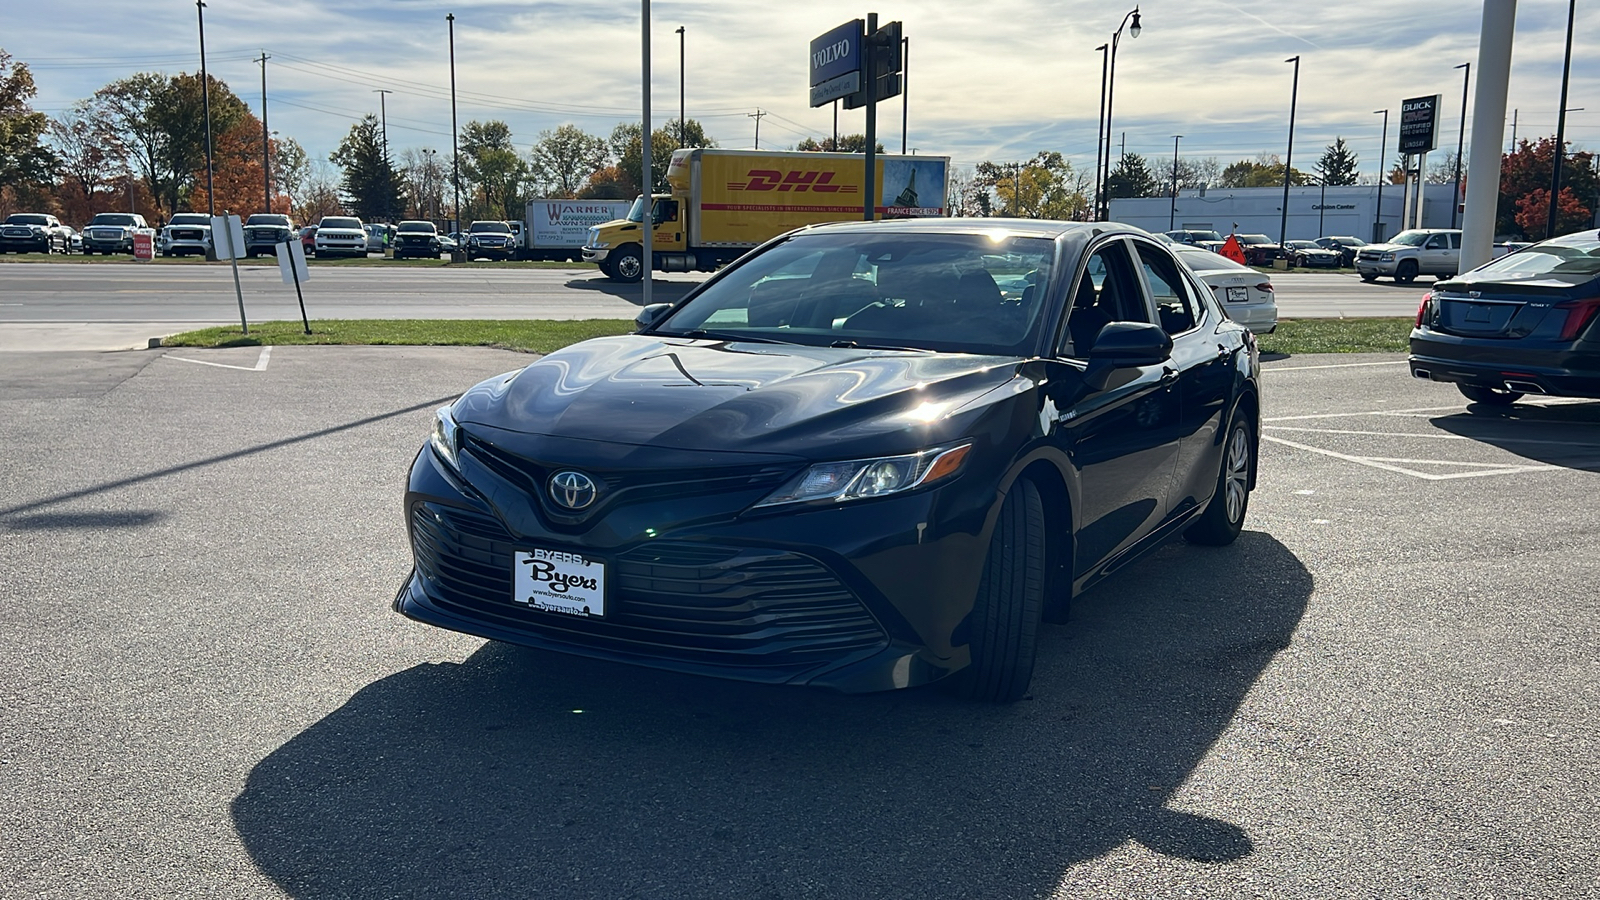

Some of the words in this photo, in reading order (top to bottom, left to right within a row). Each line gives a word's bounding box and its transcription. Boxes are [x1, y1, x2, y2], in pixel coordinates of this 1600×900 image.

[812, 39, 850, 69] VOLVO
[1403, 101, 1431, 111] BUICK
[1403, 110, 1430, 122] GMC
[1401, 122, 1431, 131] CERTIFIED
[1404, 140, 1425, 148] LINDSAY
[744, 169, 841, 193] DHL
[547, 203, 609, 221] WARNER
[887, 207, 909, 215] FRANCE
[534, 548, 583, 565] BYERS
[522, 559, 597, 593] Byers
[532, 589, 586, 603] www.byersauto.com
[528, 601, 589, 617] www.byersauto.com
